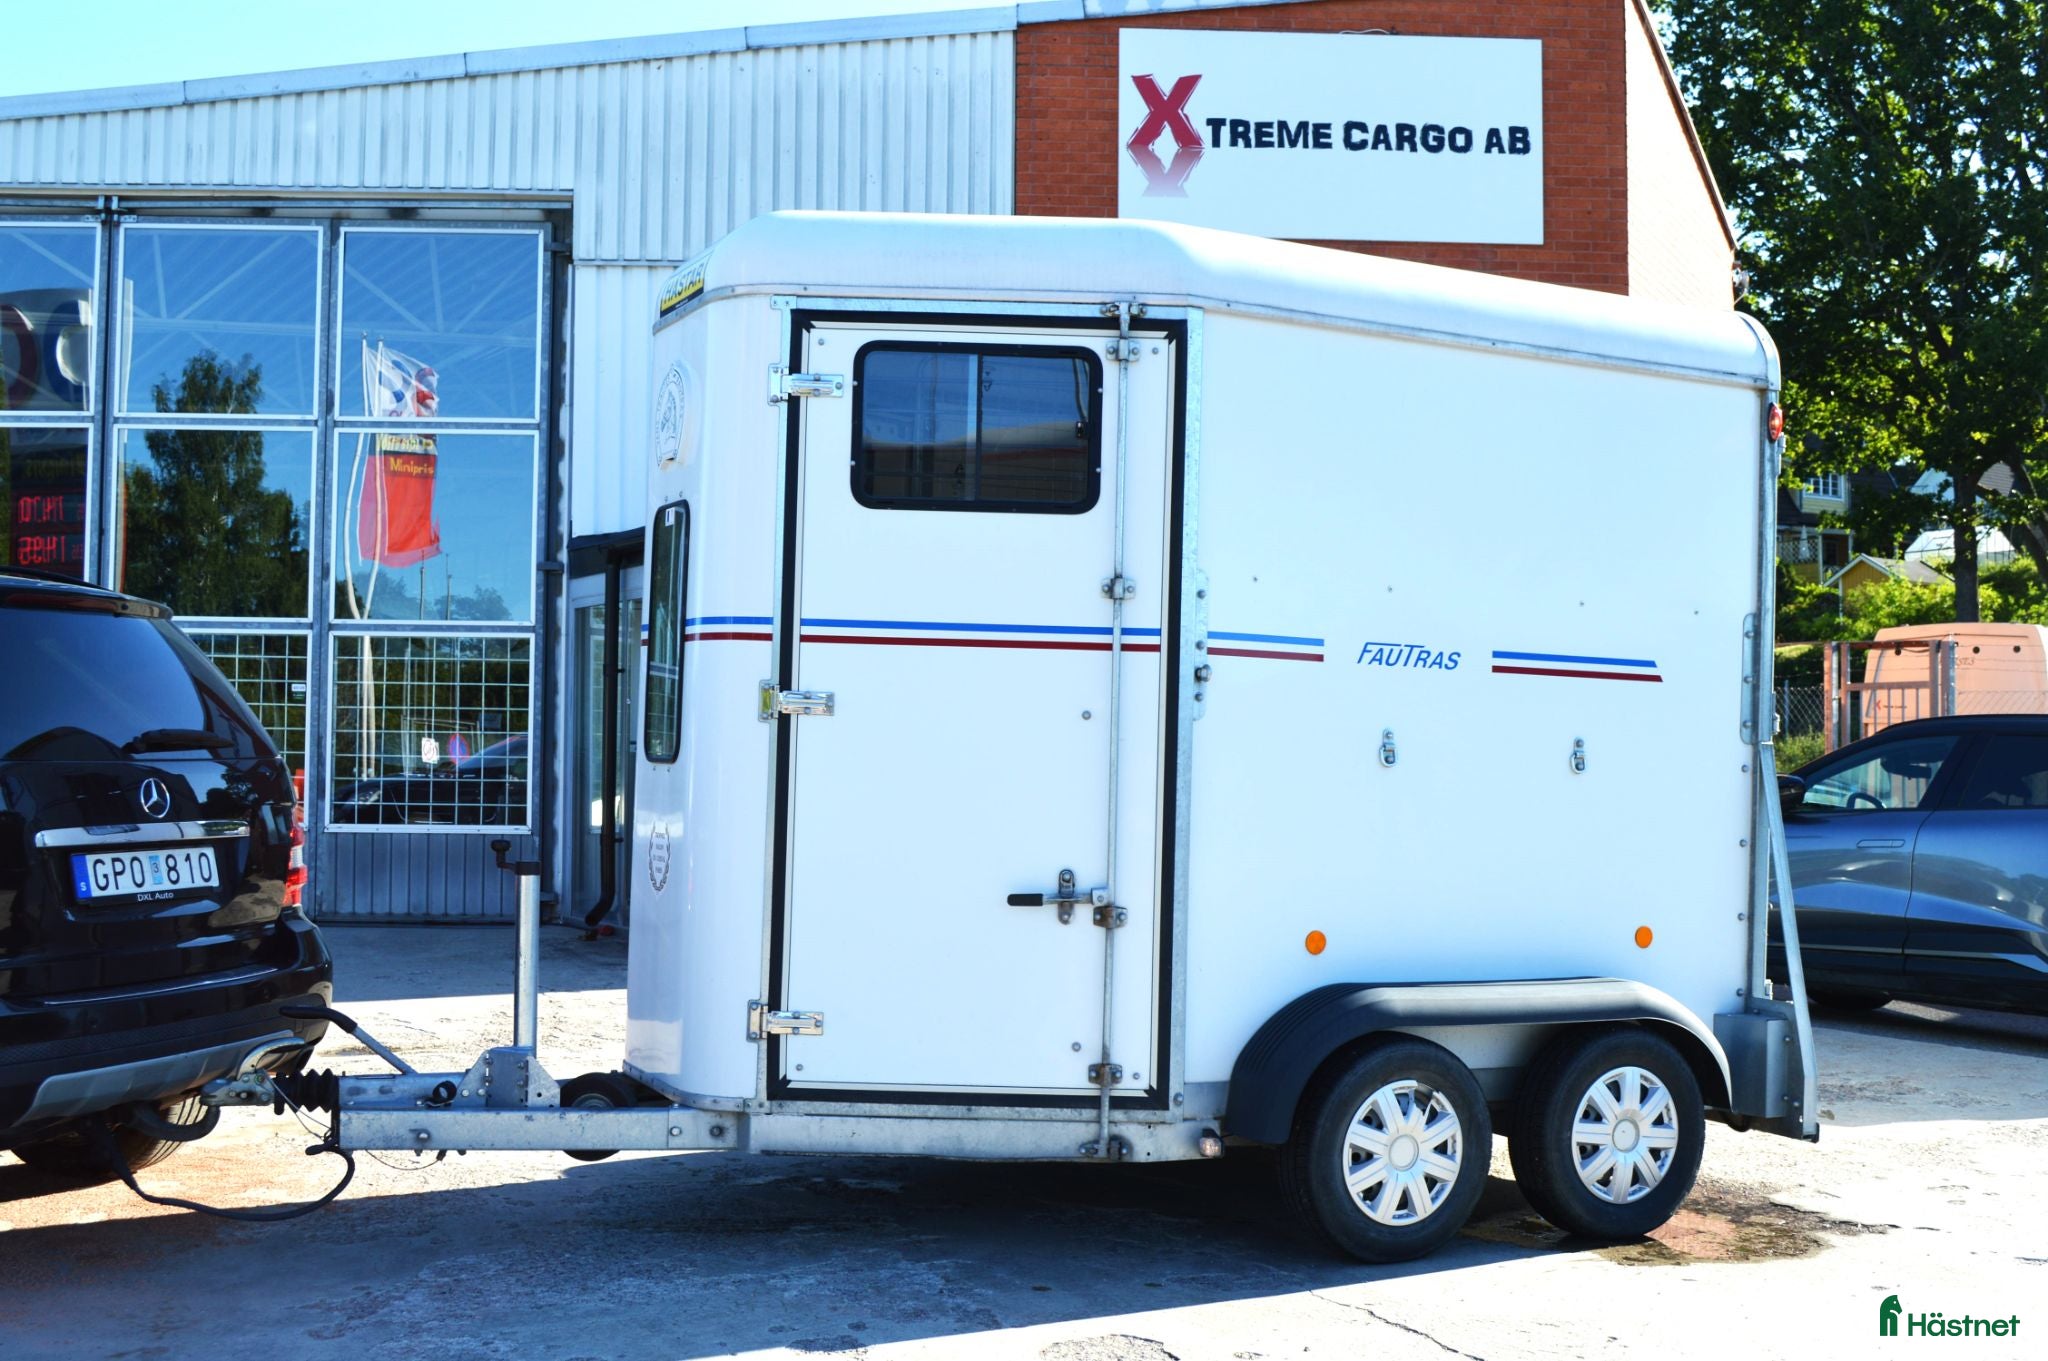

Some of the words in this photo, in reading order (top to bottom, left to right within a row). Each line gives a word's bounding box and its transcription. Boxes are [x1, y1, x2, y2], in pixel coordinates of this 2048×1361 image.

[1126, 74, 1333, 150] XTREME
[1343, 121, 1474, 154] CARGO
[1484, 126, 1531, 155] AB
[389, 456, 435, 476] Minipris
[1357, 642, 1461, 670] FAUTRAS
[93, 856, 146, 891] GPO
[165, 852, 213, 885] 810
[80, 882, 87, 891] S
[138, 893, 153, 901] DXL
